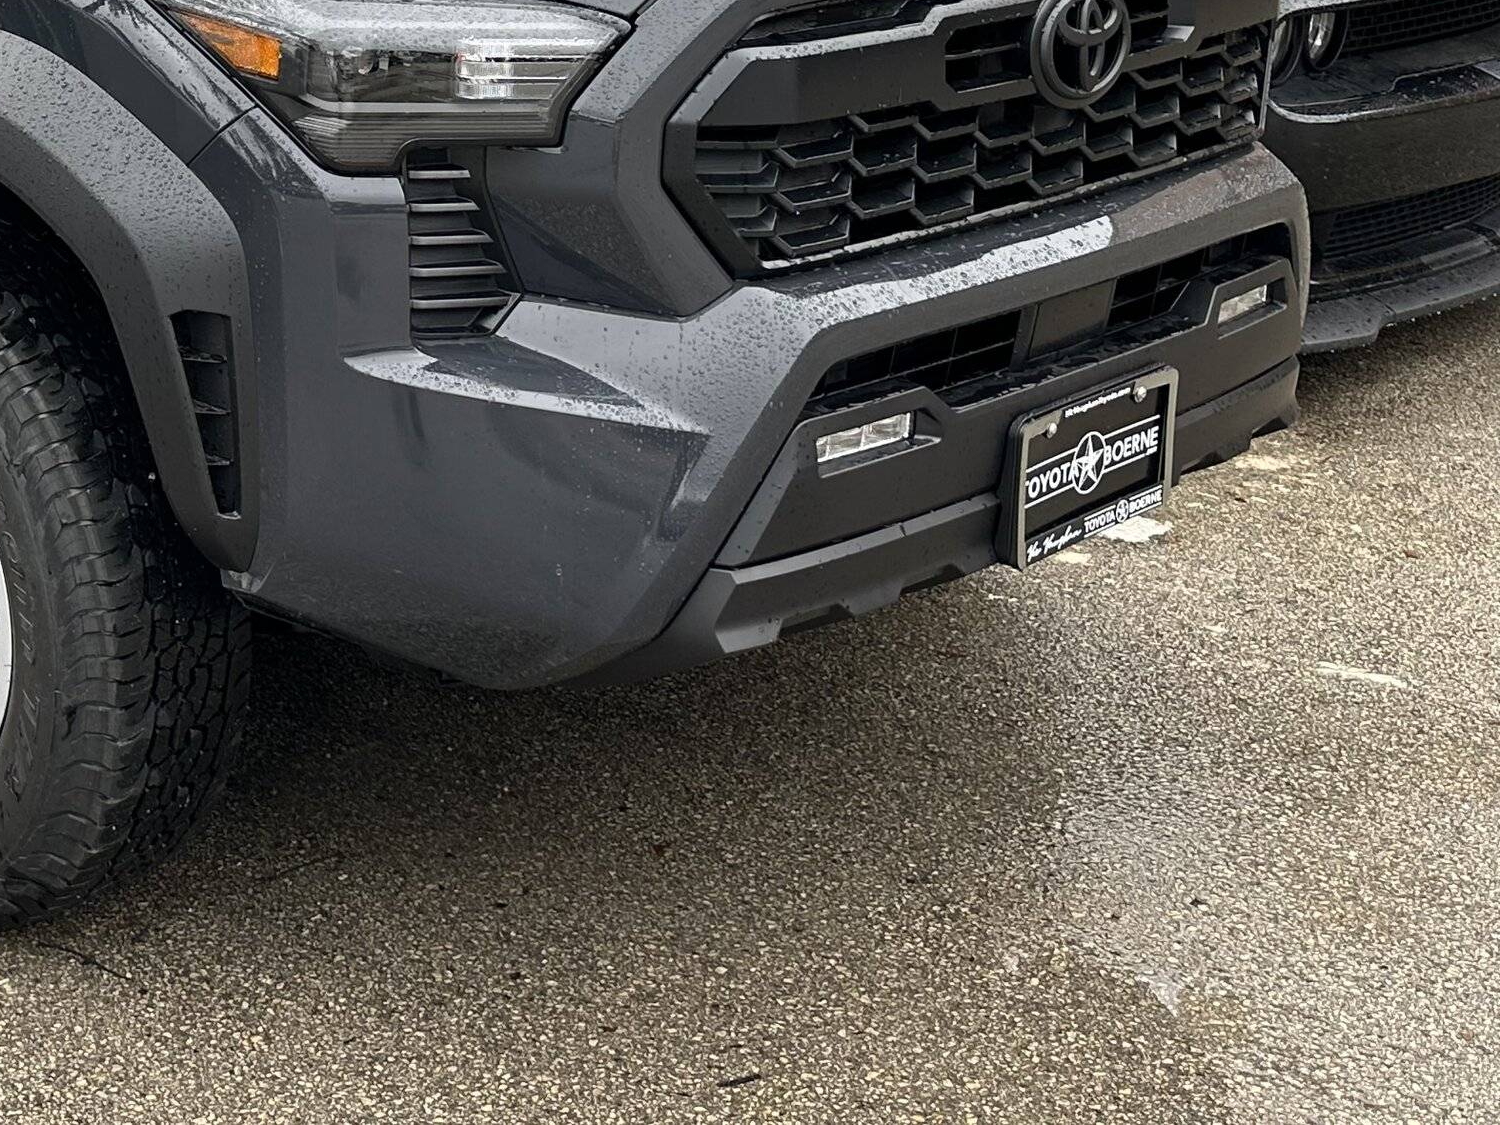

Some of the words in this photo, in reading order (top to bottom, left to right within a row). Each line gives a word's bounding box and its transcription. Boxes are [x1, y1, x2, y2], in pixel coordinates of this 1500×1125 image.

[1025, 461, 1079, 499] OYOTA
[1103, 425, 1160, 466] BOERNE
[1083, 512, 1116, 533] TOYOTA
[1128, 489, 1163, 514] BOERNE
